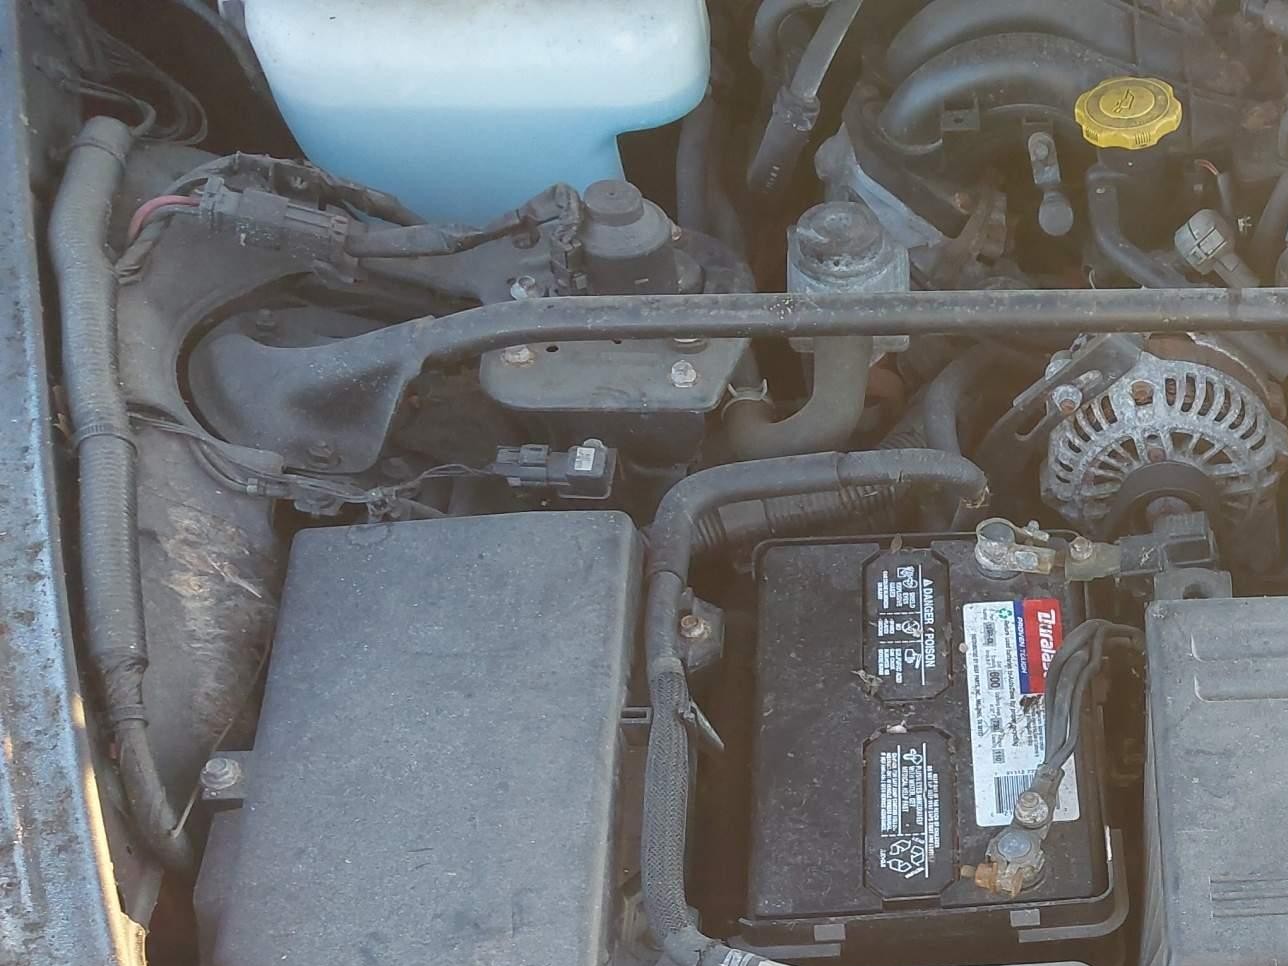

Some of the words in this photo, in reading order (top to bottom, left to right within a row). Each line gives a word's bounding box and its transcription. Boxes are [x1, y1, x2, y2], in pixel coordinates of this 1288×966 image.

[924, 588, 934, 624] DANGER
[1017, 616, 1026, 647] PROVEN
[924, 634, 935, 668] POISON
[1020, 649, 1028, 674] TOUGH
[990, 671, 1000, 688] 600
